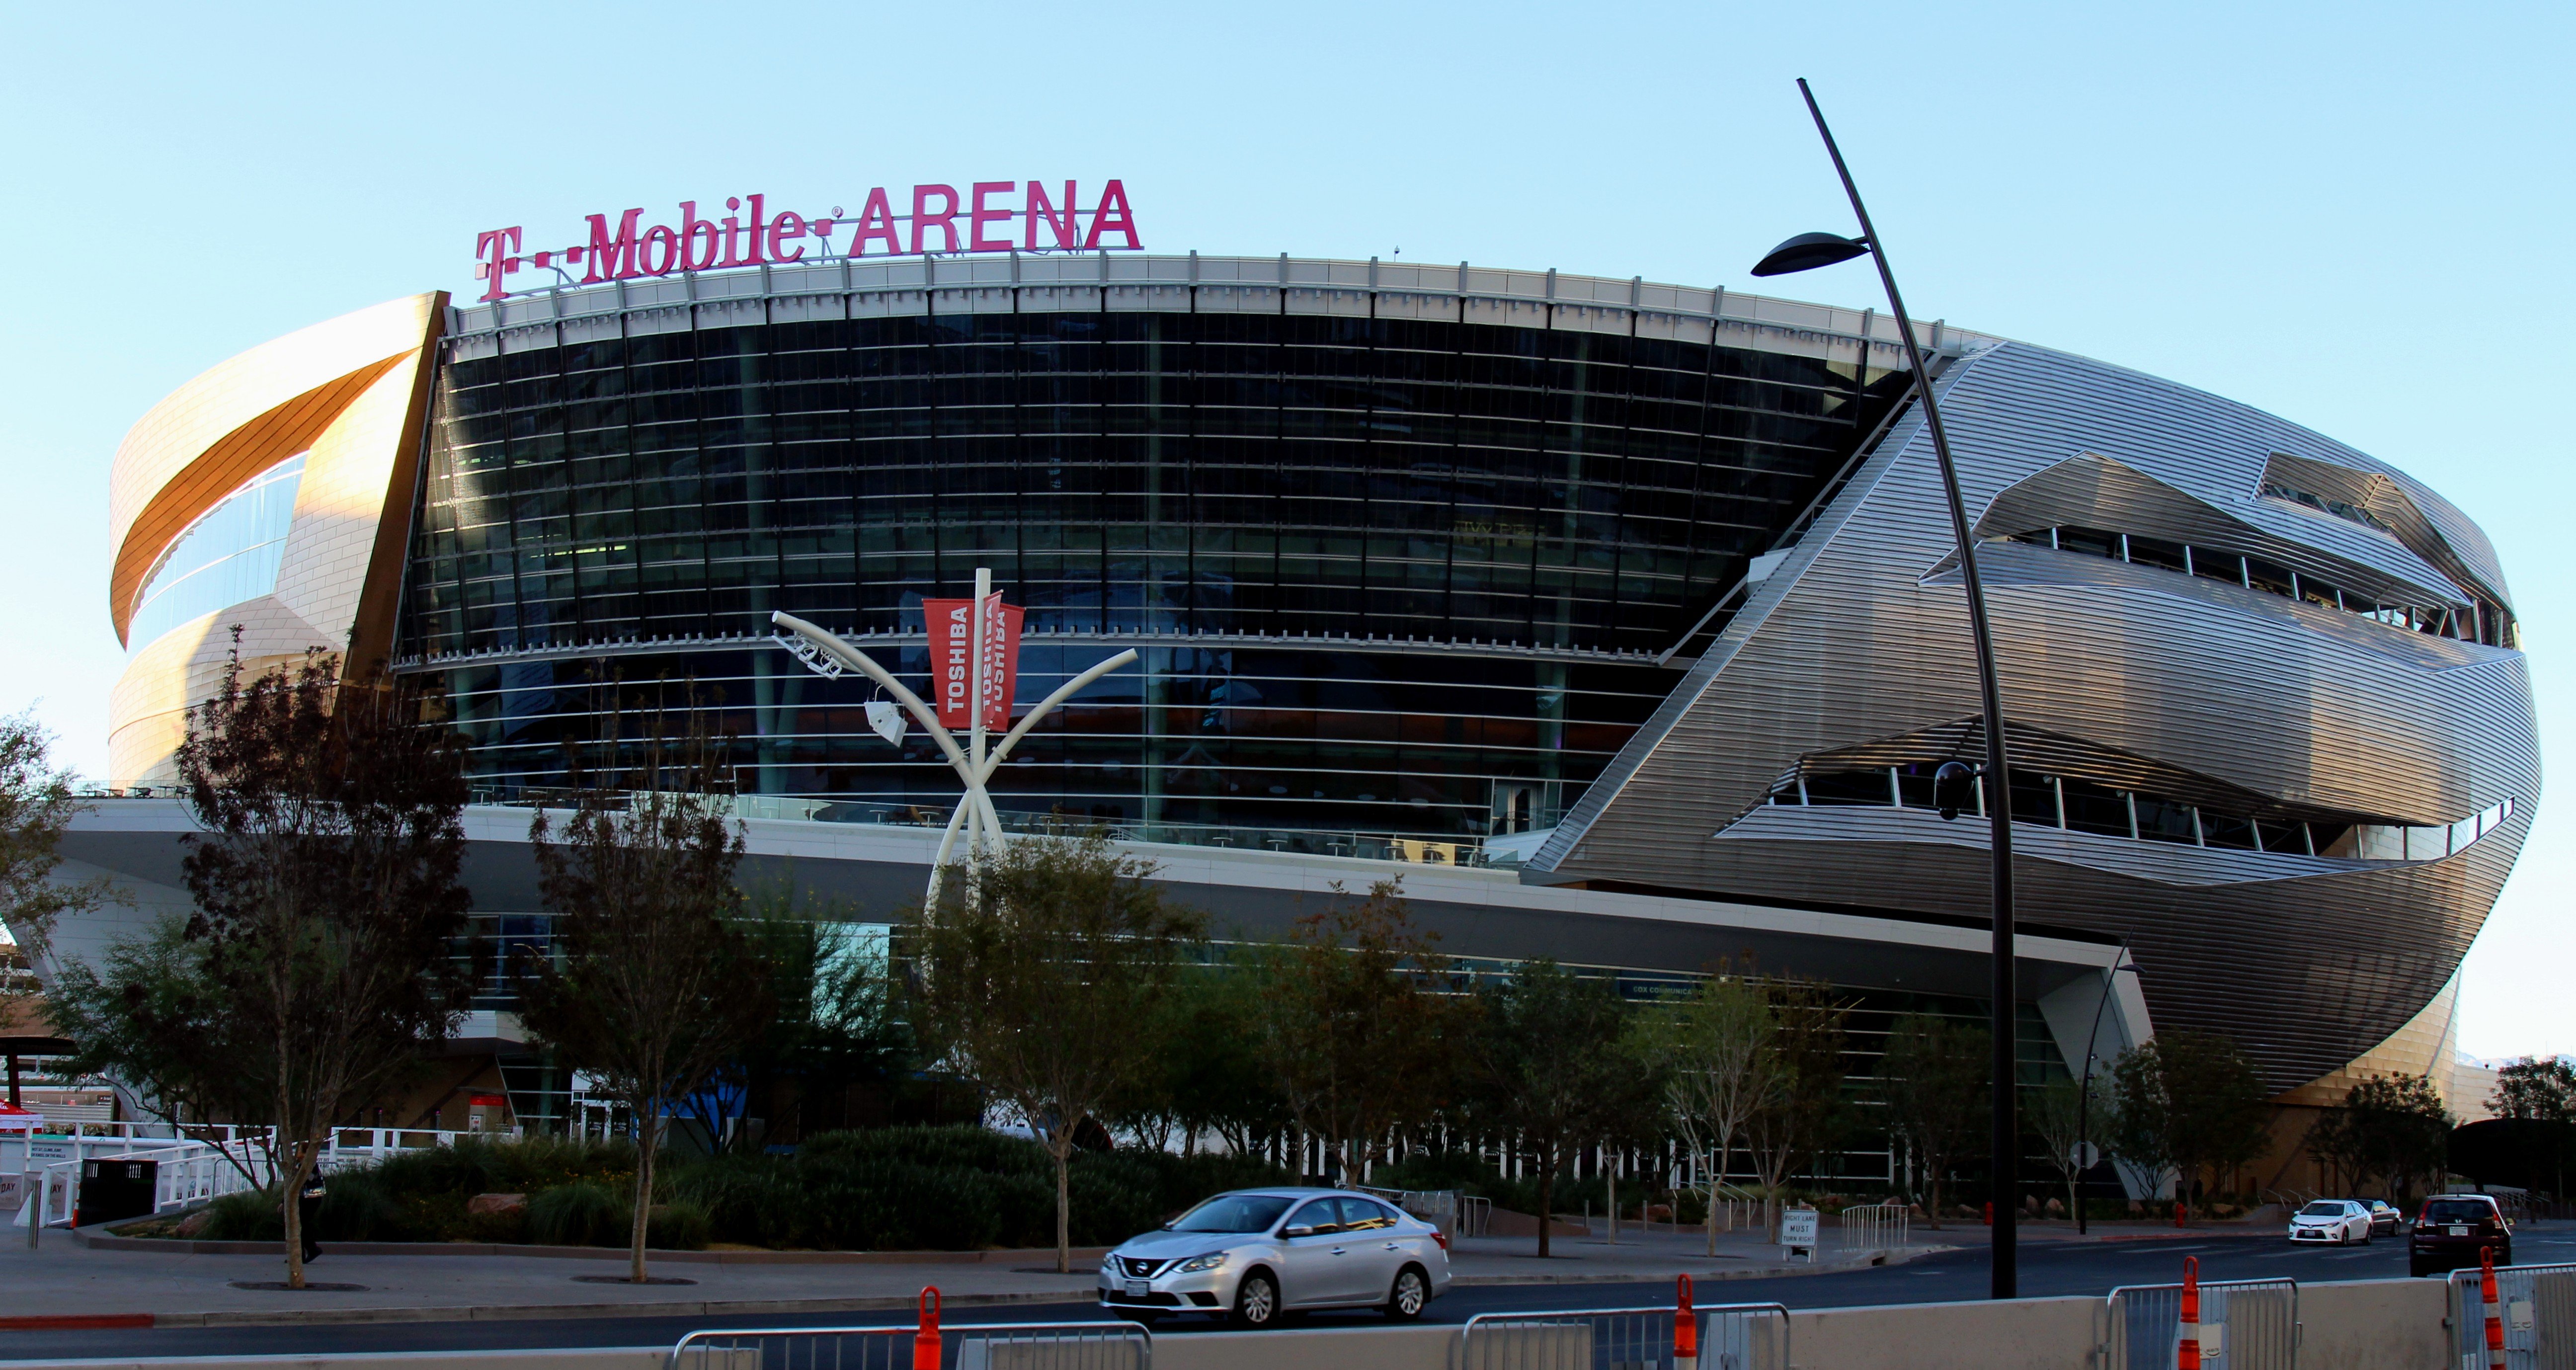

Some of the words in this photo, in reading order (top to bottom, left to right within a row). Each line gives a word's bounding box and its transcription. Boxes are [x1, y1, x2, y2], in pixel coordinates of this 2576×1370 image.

[848, 179, 1141, 257] ARENA
[947, 607, 967, 713] TOSHIBA
[983, 603, 993, 712] TOSHIBA
